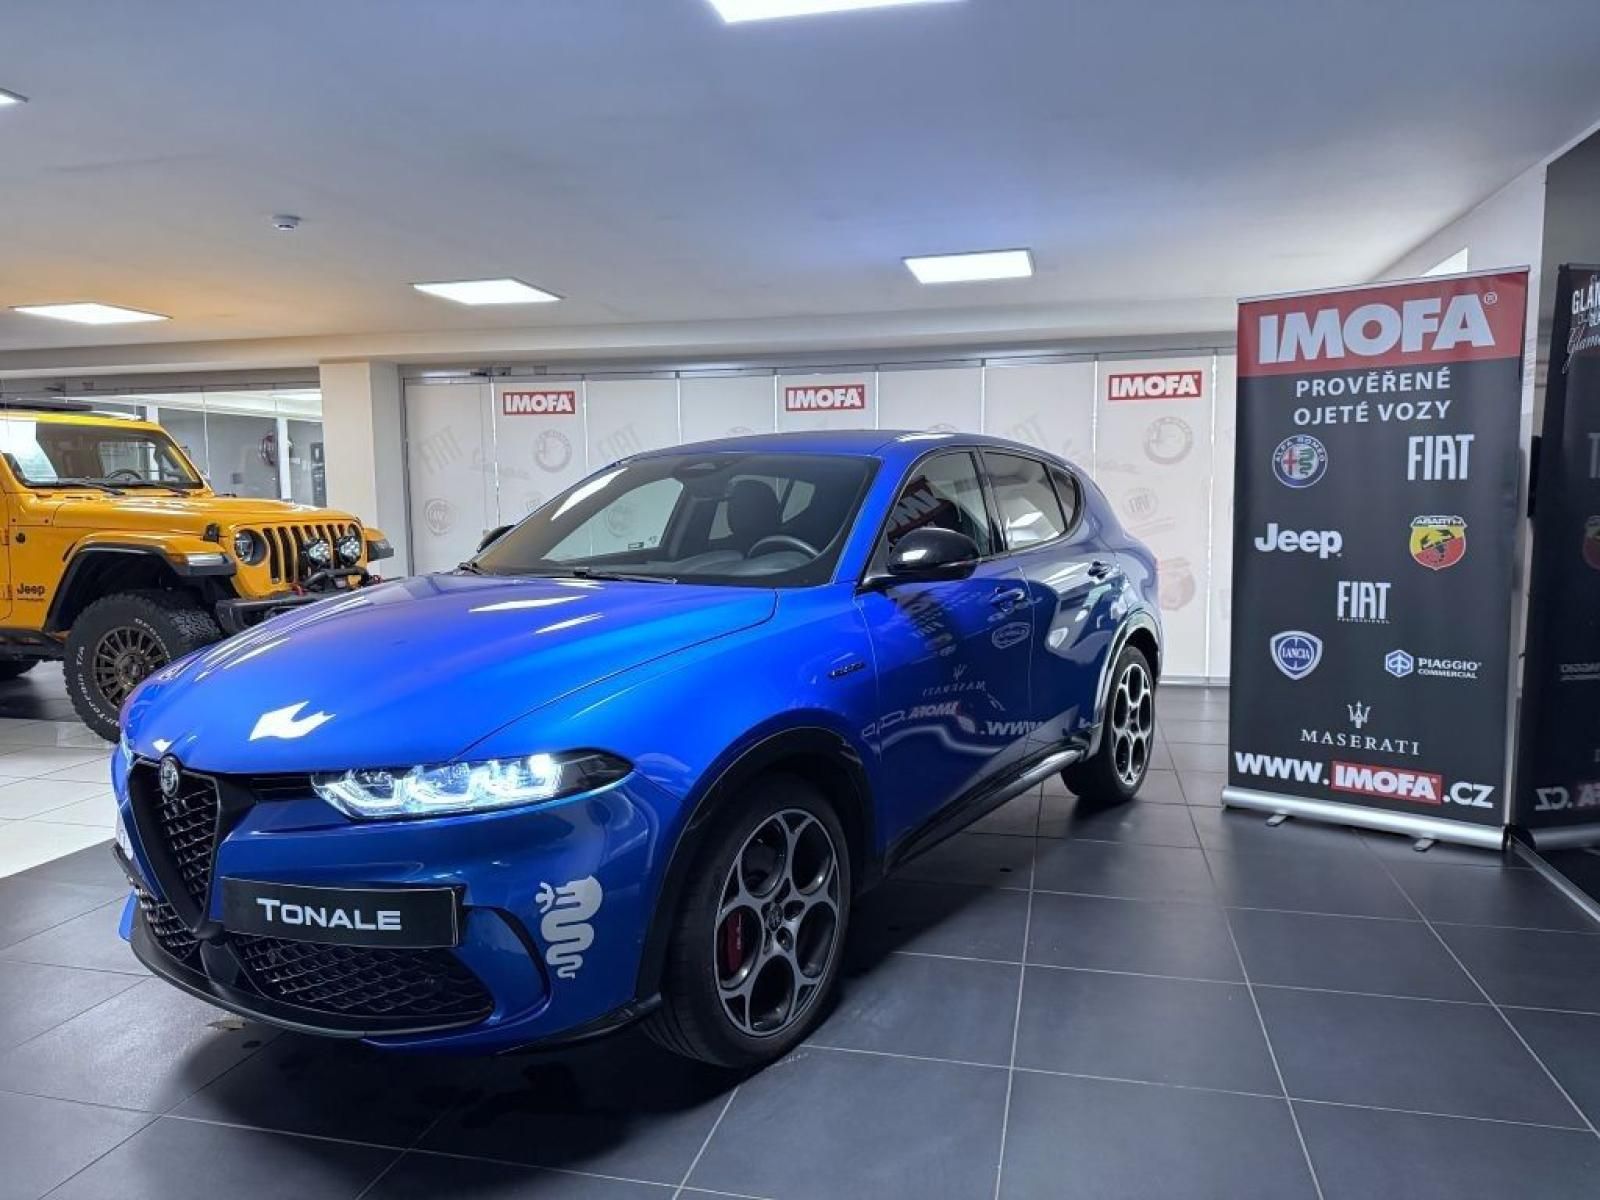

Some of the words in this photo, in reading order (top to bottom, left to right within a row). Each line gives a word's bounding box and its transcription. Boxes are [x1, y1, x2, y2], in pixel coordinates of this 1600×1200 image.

[1258, 294, 1495, 364] IMOFA
[1111, 374, 1199, 397] IMOFA
[1295, 366, 1451, 398] PROVĚŘENÉ
[505, 394, 572, 412] IMOFA
[788, 388, 862, 409] IMOFA
[1293, 401, 1370, 426] OJETÉ
[1378, 400, 1451, 421] VOZY
[1407, 434, 1475, 481] FIAT
[1254, 523, 1343, 558] Jeep
[16, 582, 46, 597] Jeep
[1337, 580, 1391, 619] FIAT
[1282, 647, 1310, 660] LANCIA
[1417, 657, 1478, 671] PIAGGIO
[1417, 668, 1478, 679] COMMERCIAL
[1299, 729, 1419, 756] MASERATI
